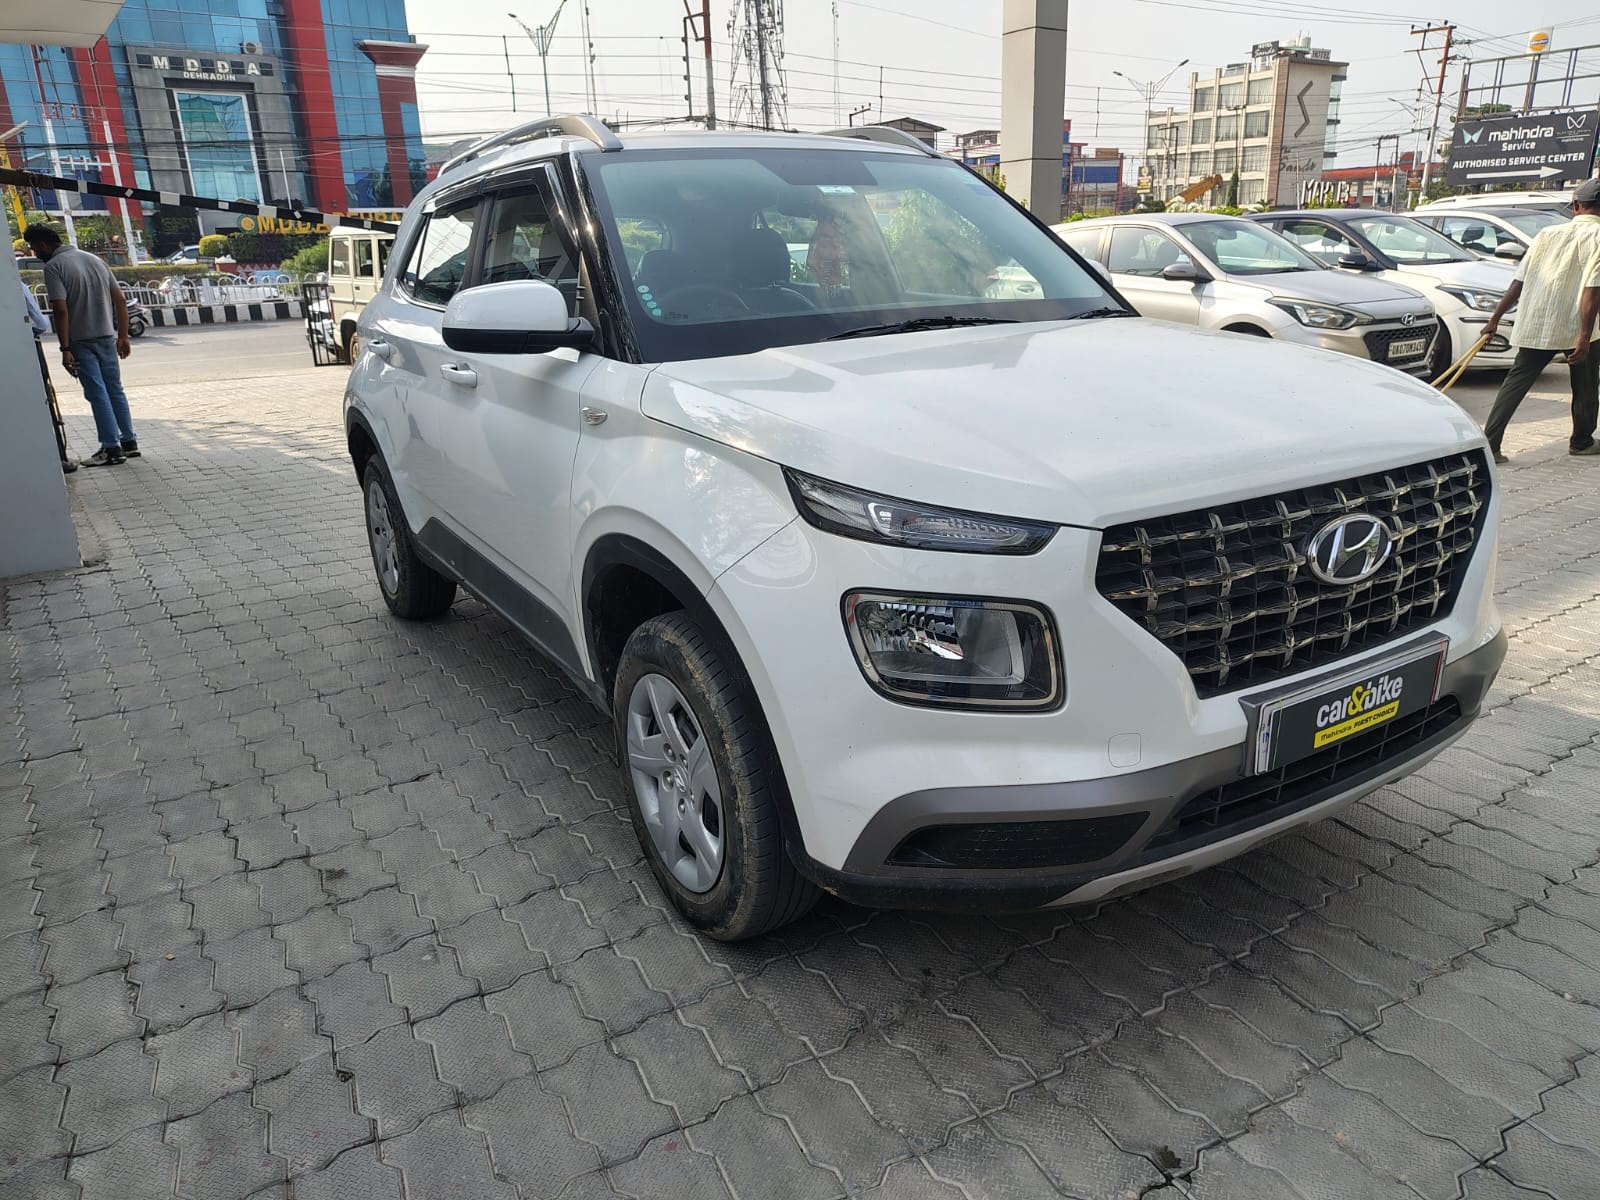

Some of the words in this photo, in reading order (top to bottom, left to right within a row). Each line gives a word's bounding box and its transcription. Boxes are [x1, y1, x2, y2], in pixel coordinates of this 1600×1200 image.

[183, 71, 236, 81] DEHRADUN
[1488, 125, 1554, 142] mahindra
[1501, 141, 1536, 152] Service
[1452, 158, 1507, 169] AUTHORISED
[1508, 155, 1546, 166] SERVICE
[1548, 152, 1585, 163] CENTER
[1316, 674, 1403, 728] car&bike
[1353, 715, 1374, 728] FIRST
[1373, 706, 1395, 721] CHOICE
